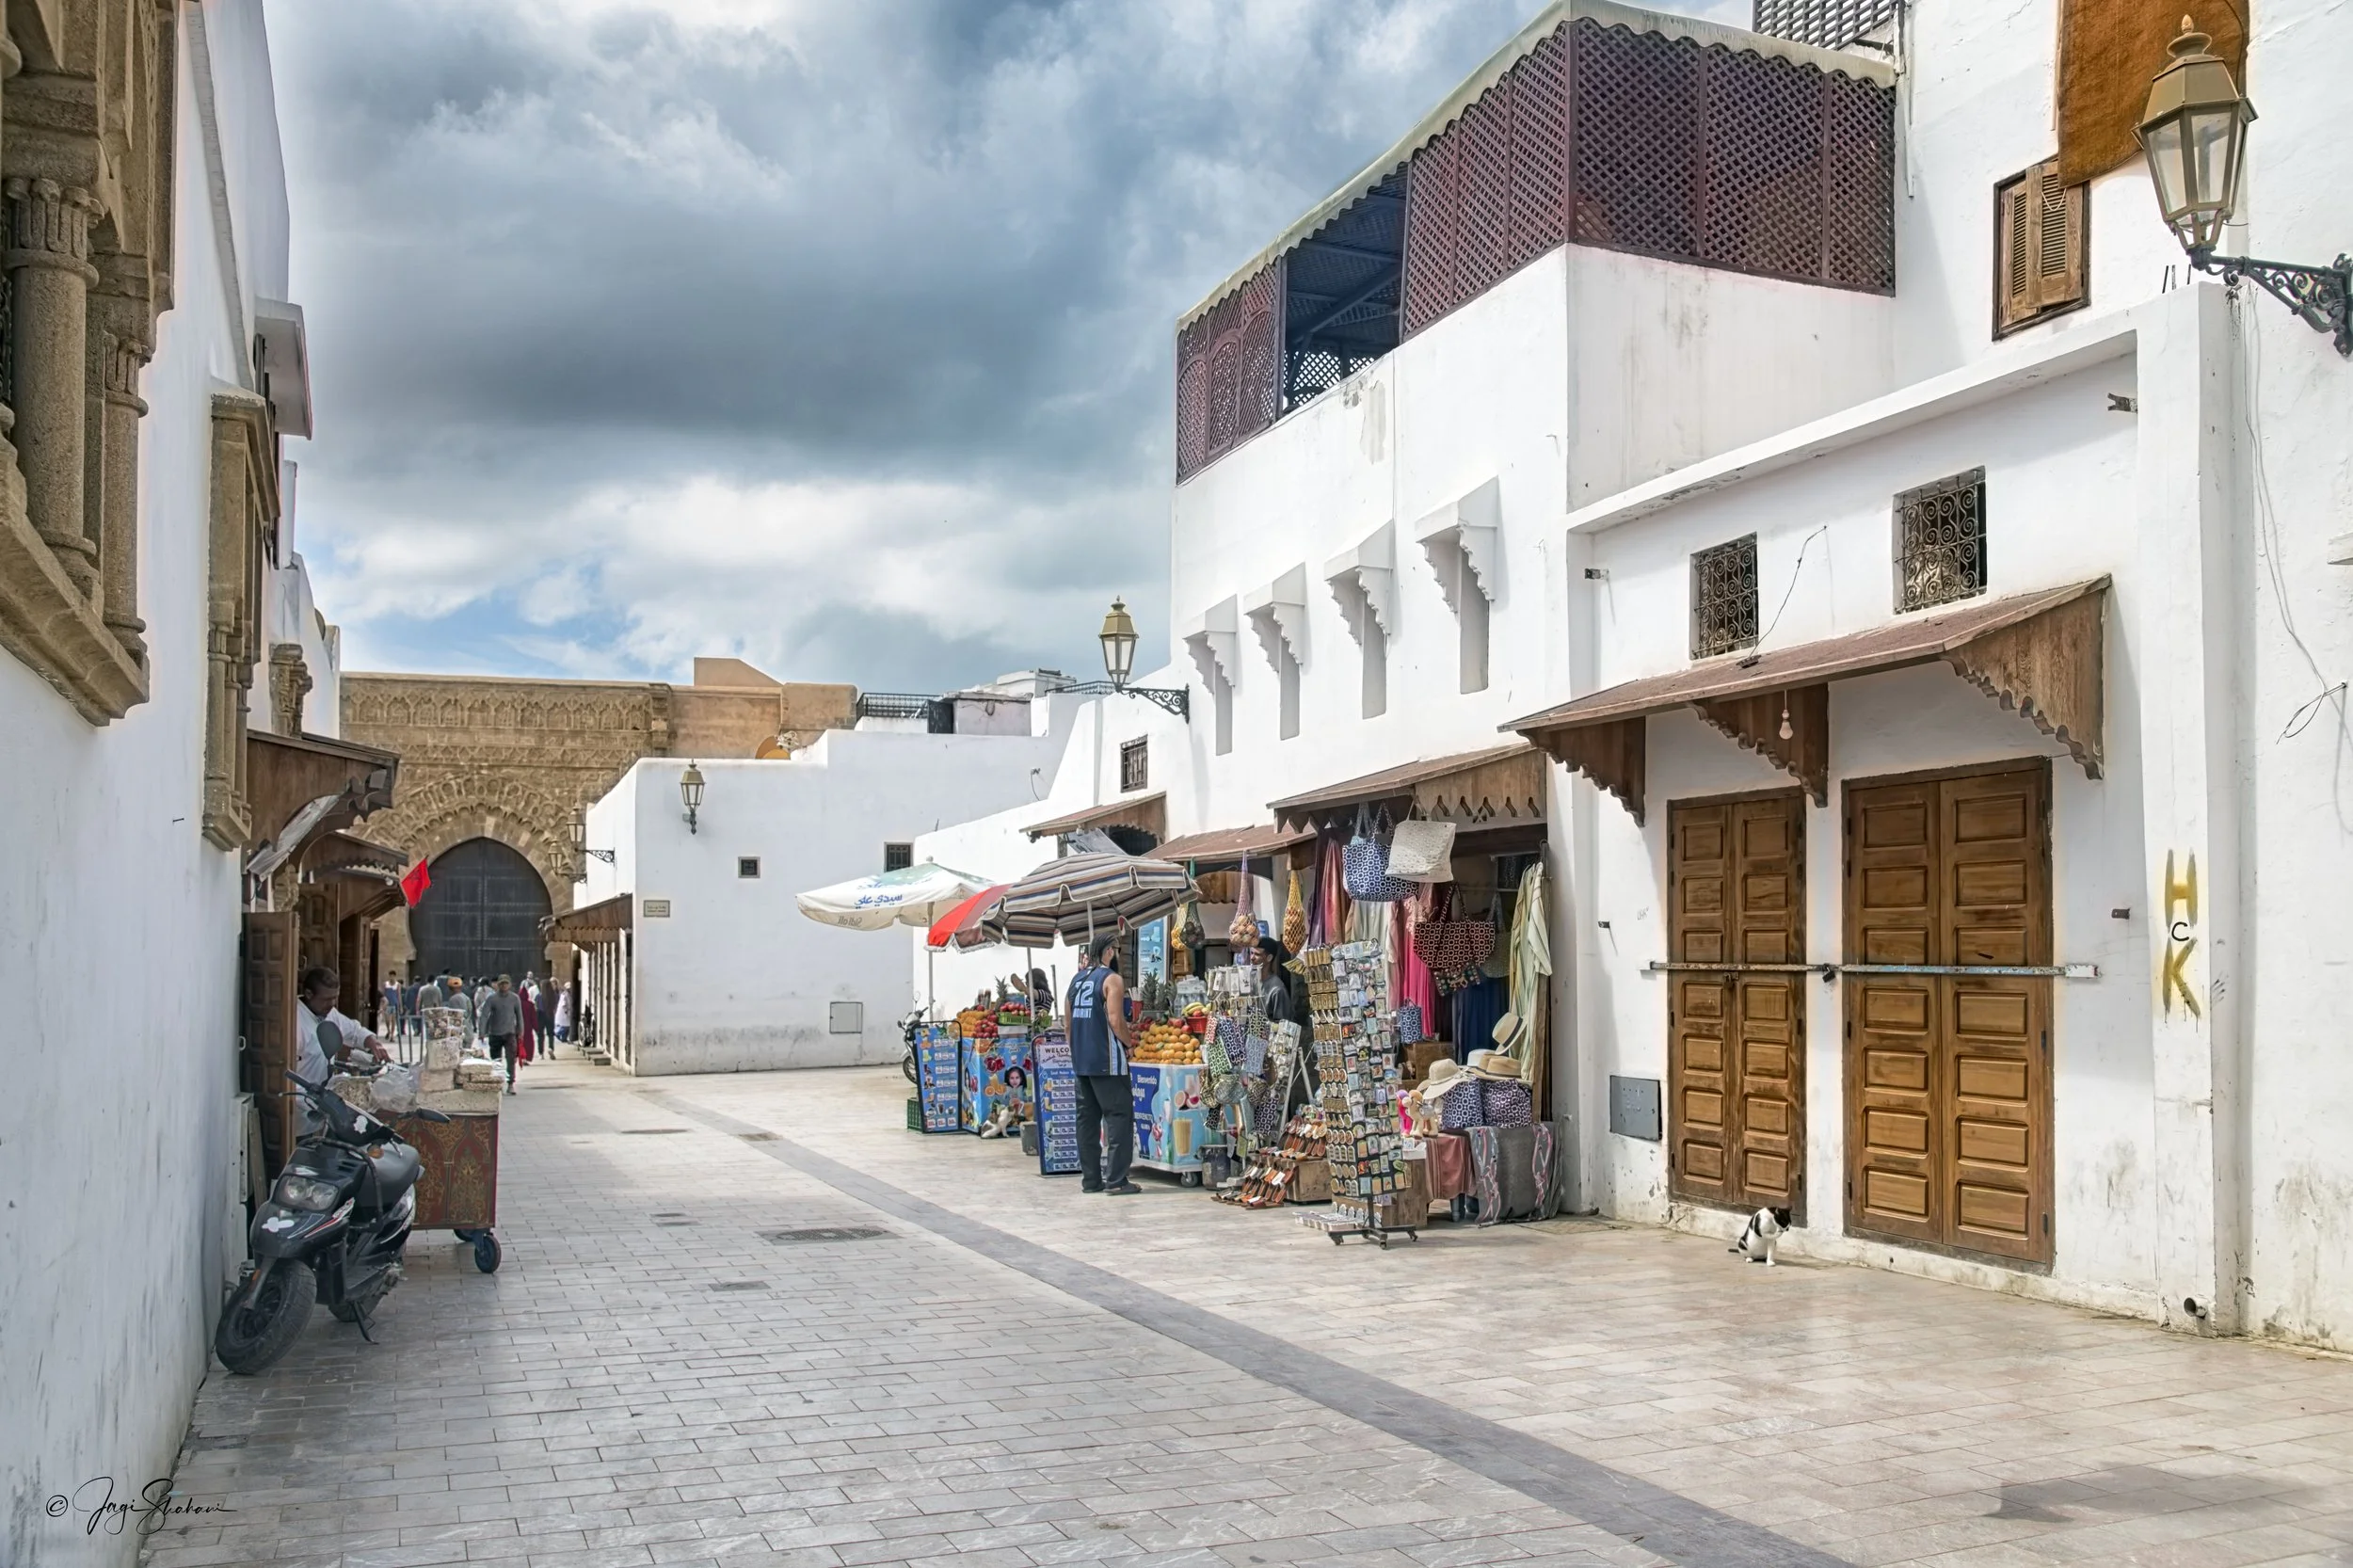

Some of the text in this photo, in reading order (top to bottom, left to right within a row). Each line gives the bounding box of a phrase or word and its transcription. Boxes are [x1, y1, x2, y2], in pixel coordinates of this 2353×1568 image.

[854, 894, 904, 909] سيدي علي
[1074, 981, 1095, 1006] 12
[1137, 1074, 1158, 1085] Bienvenido
